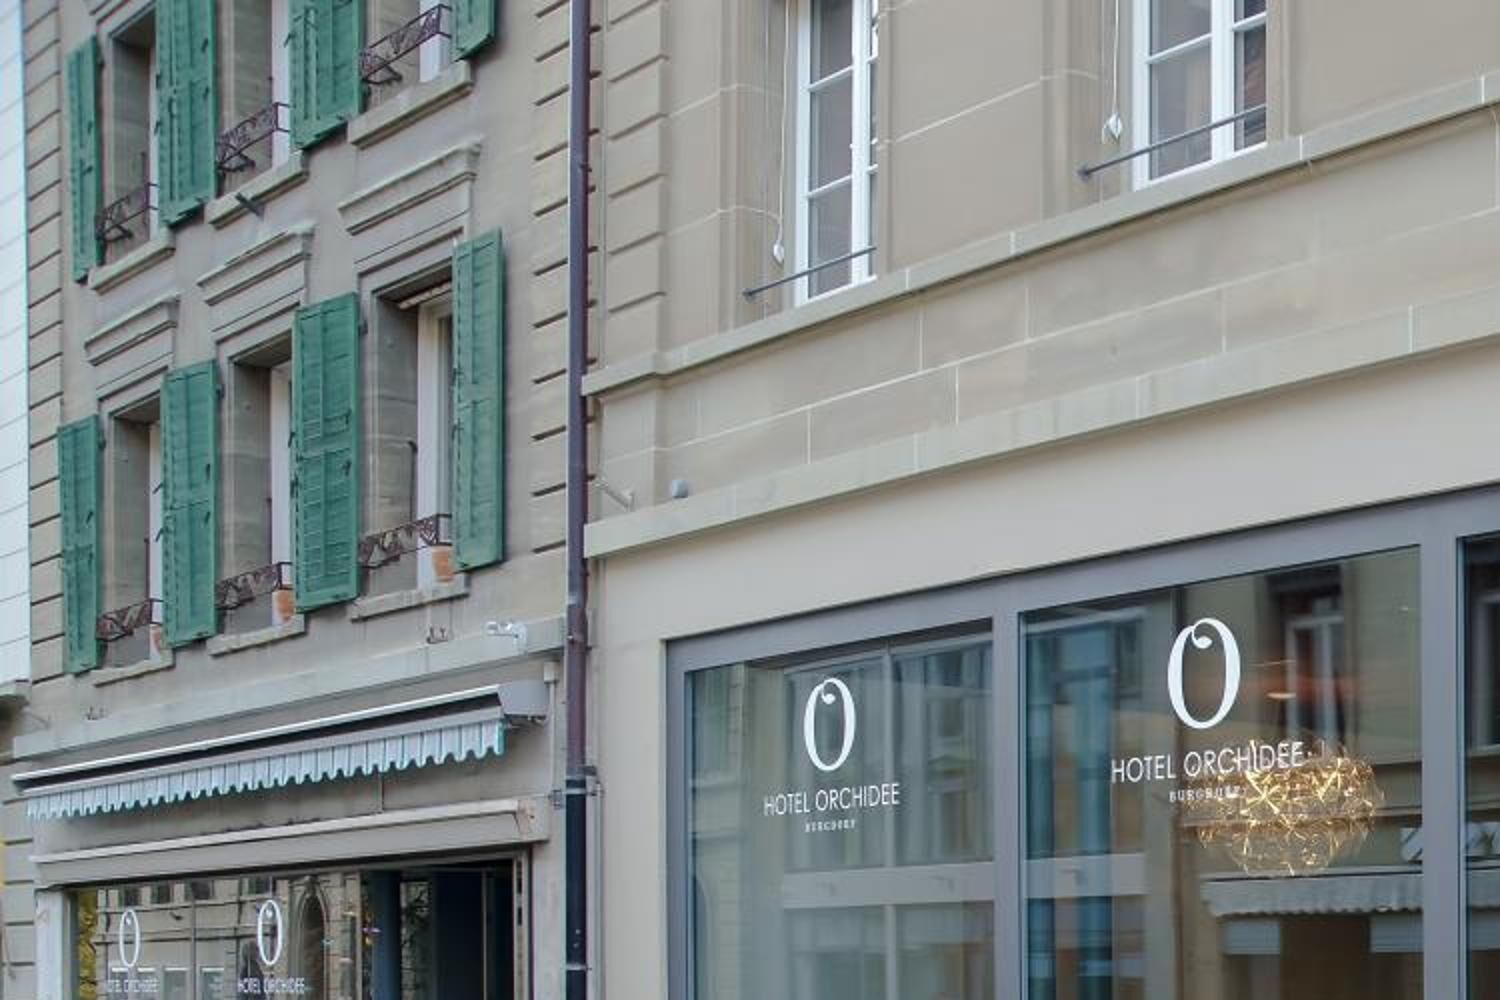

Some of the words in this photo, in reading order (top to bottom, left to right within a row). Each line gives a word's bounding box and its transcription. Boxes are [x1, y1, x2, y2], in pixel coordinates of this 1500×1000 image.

[1111, 754, 1176, 783] HOTEL
[1183, 741, 1304, 777] ORCHIDEE
[763, 792, 810, 816] HOTEL
[815, 783, 900, 811] ORCHIDEE
